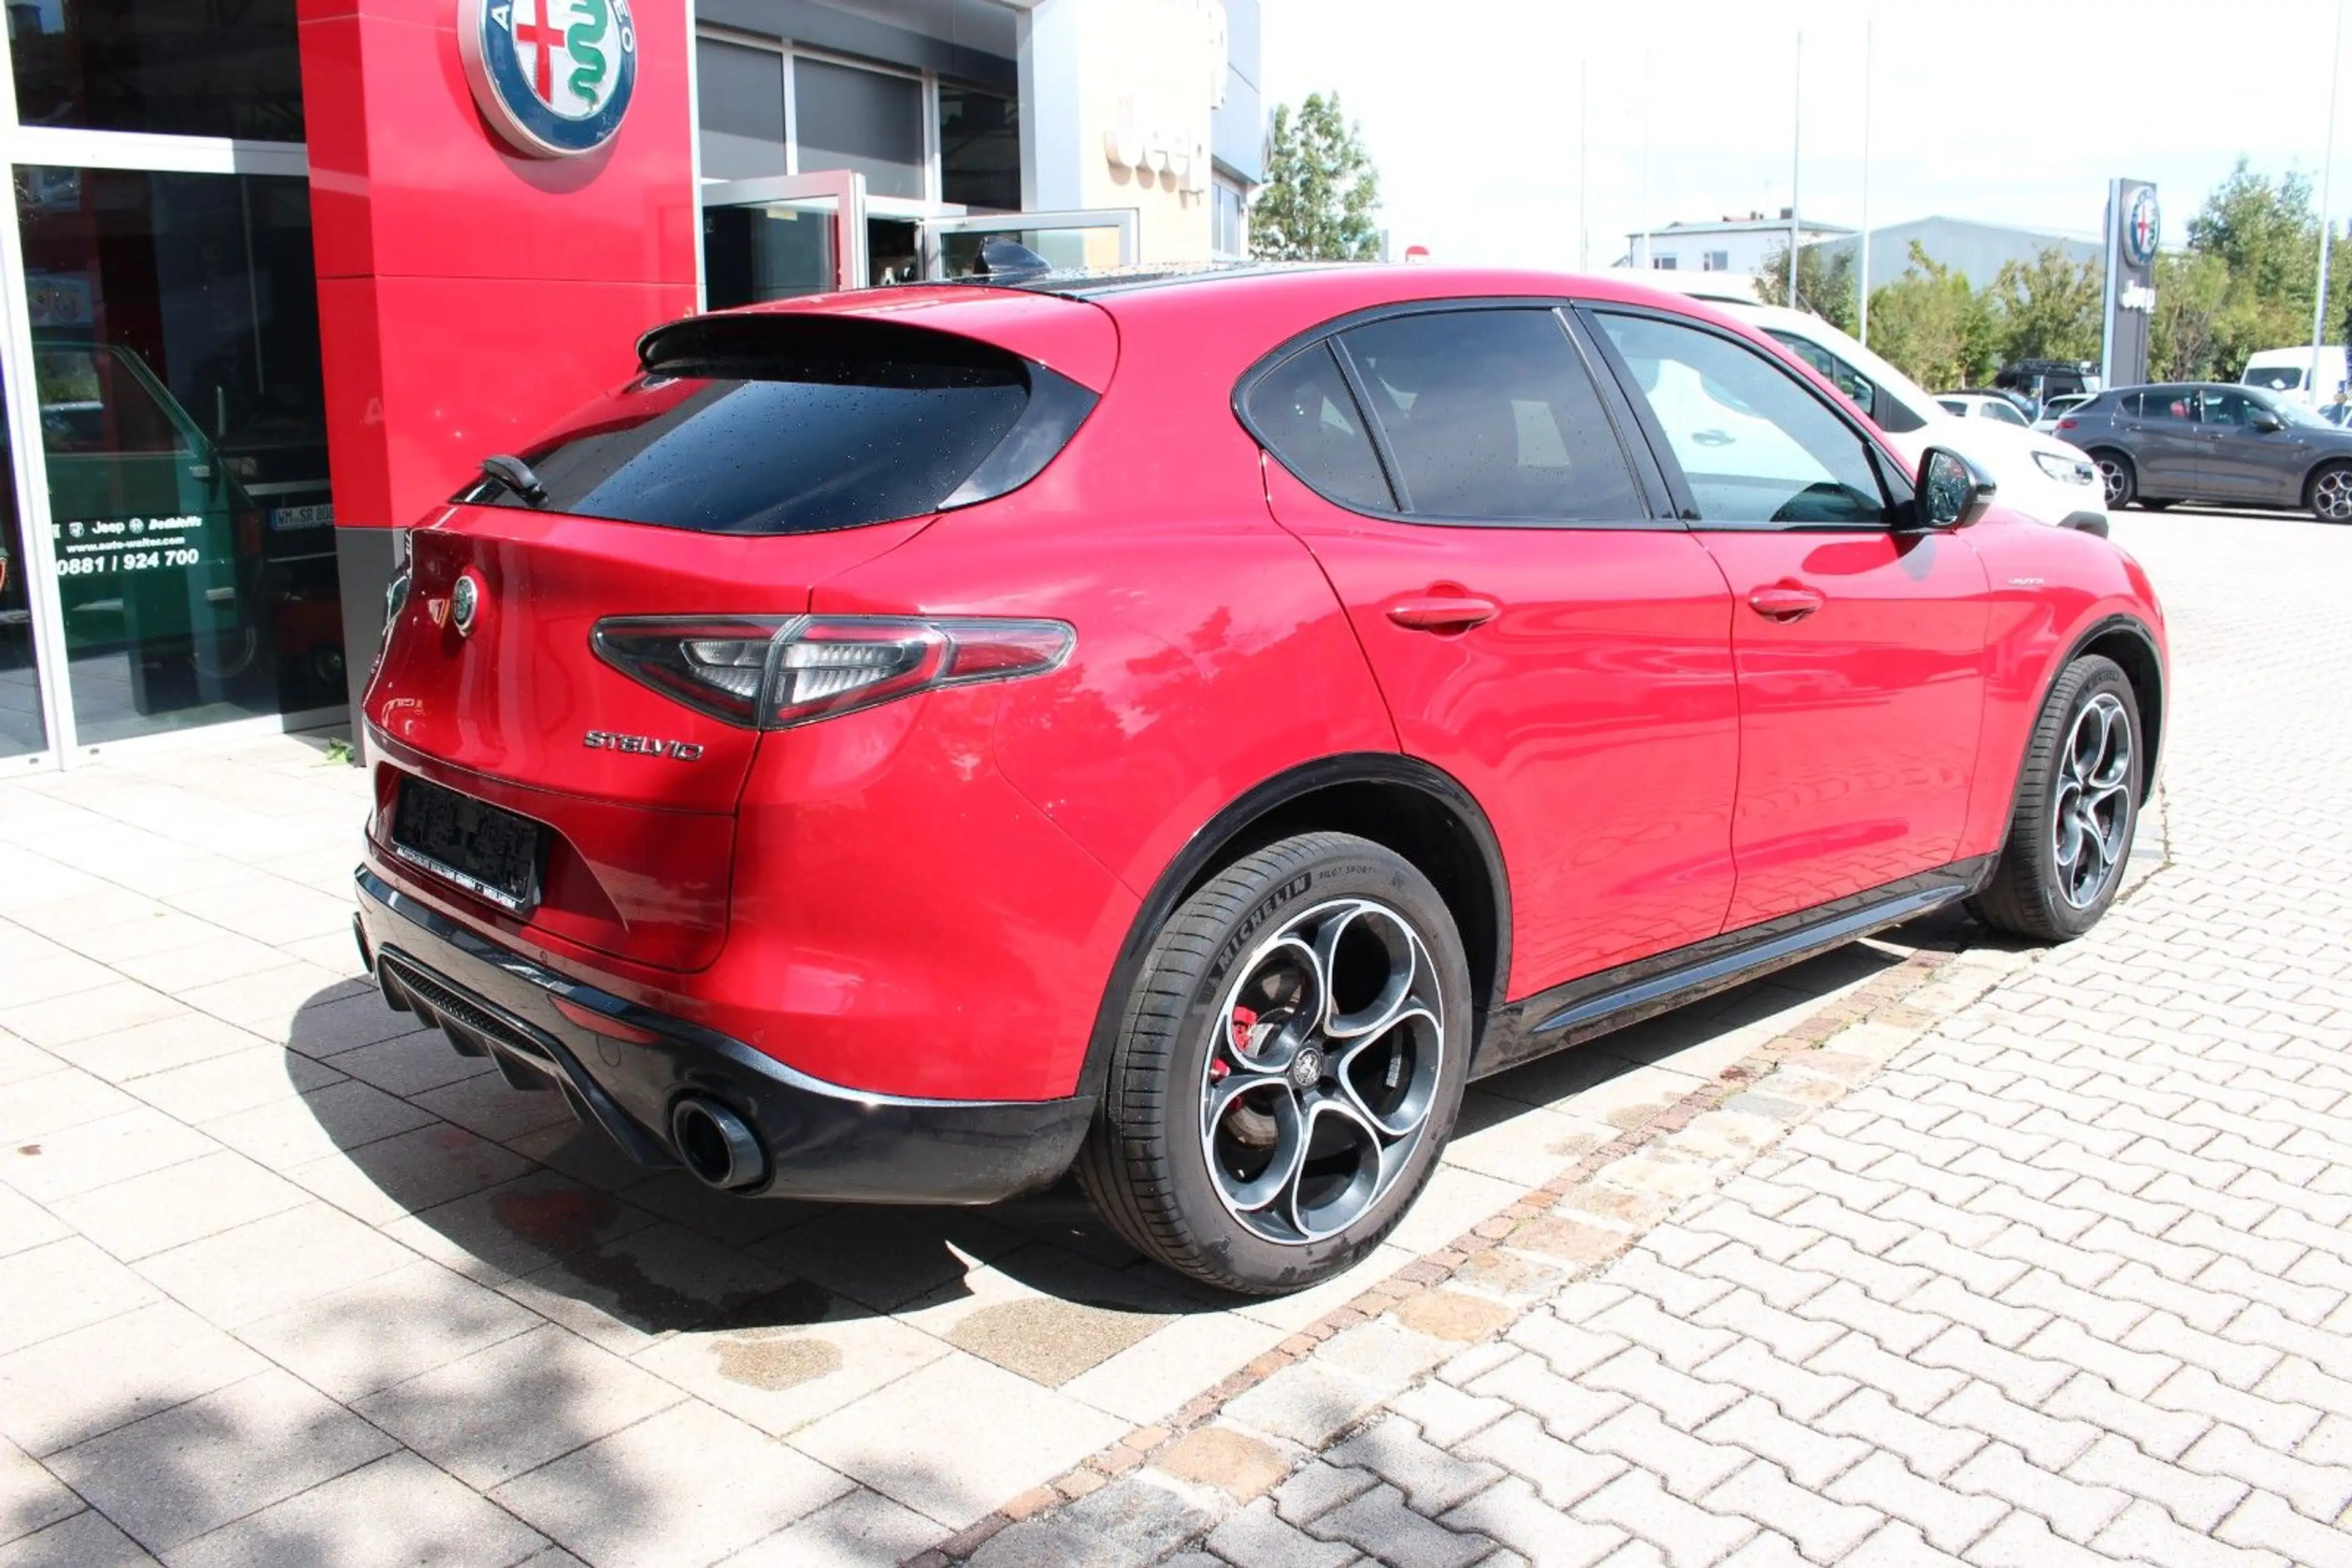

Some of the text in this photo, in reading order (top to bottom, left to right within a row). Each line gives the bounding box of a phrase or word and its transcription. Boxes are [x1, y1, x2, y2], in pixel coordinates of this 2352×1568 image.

[91, 521, 125, 535] Jeep
[56, 556, 105, 576] 0881
[123, 551, 160, 570] 924
[164, 548, 200, 567] 700
[584, 729, 704, 761] STELVIO
[1218, 874, 1307, 973] MICHELIN
